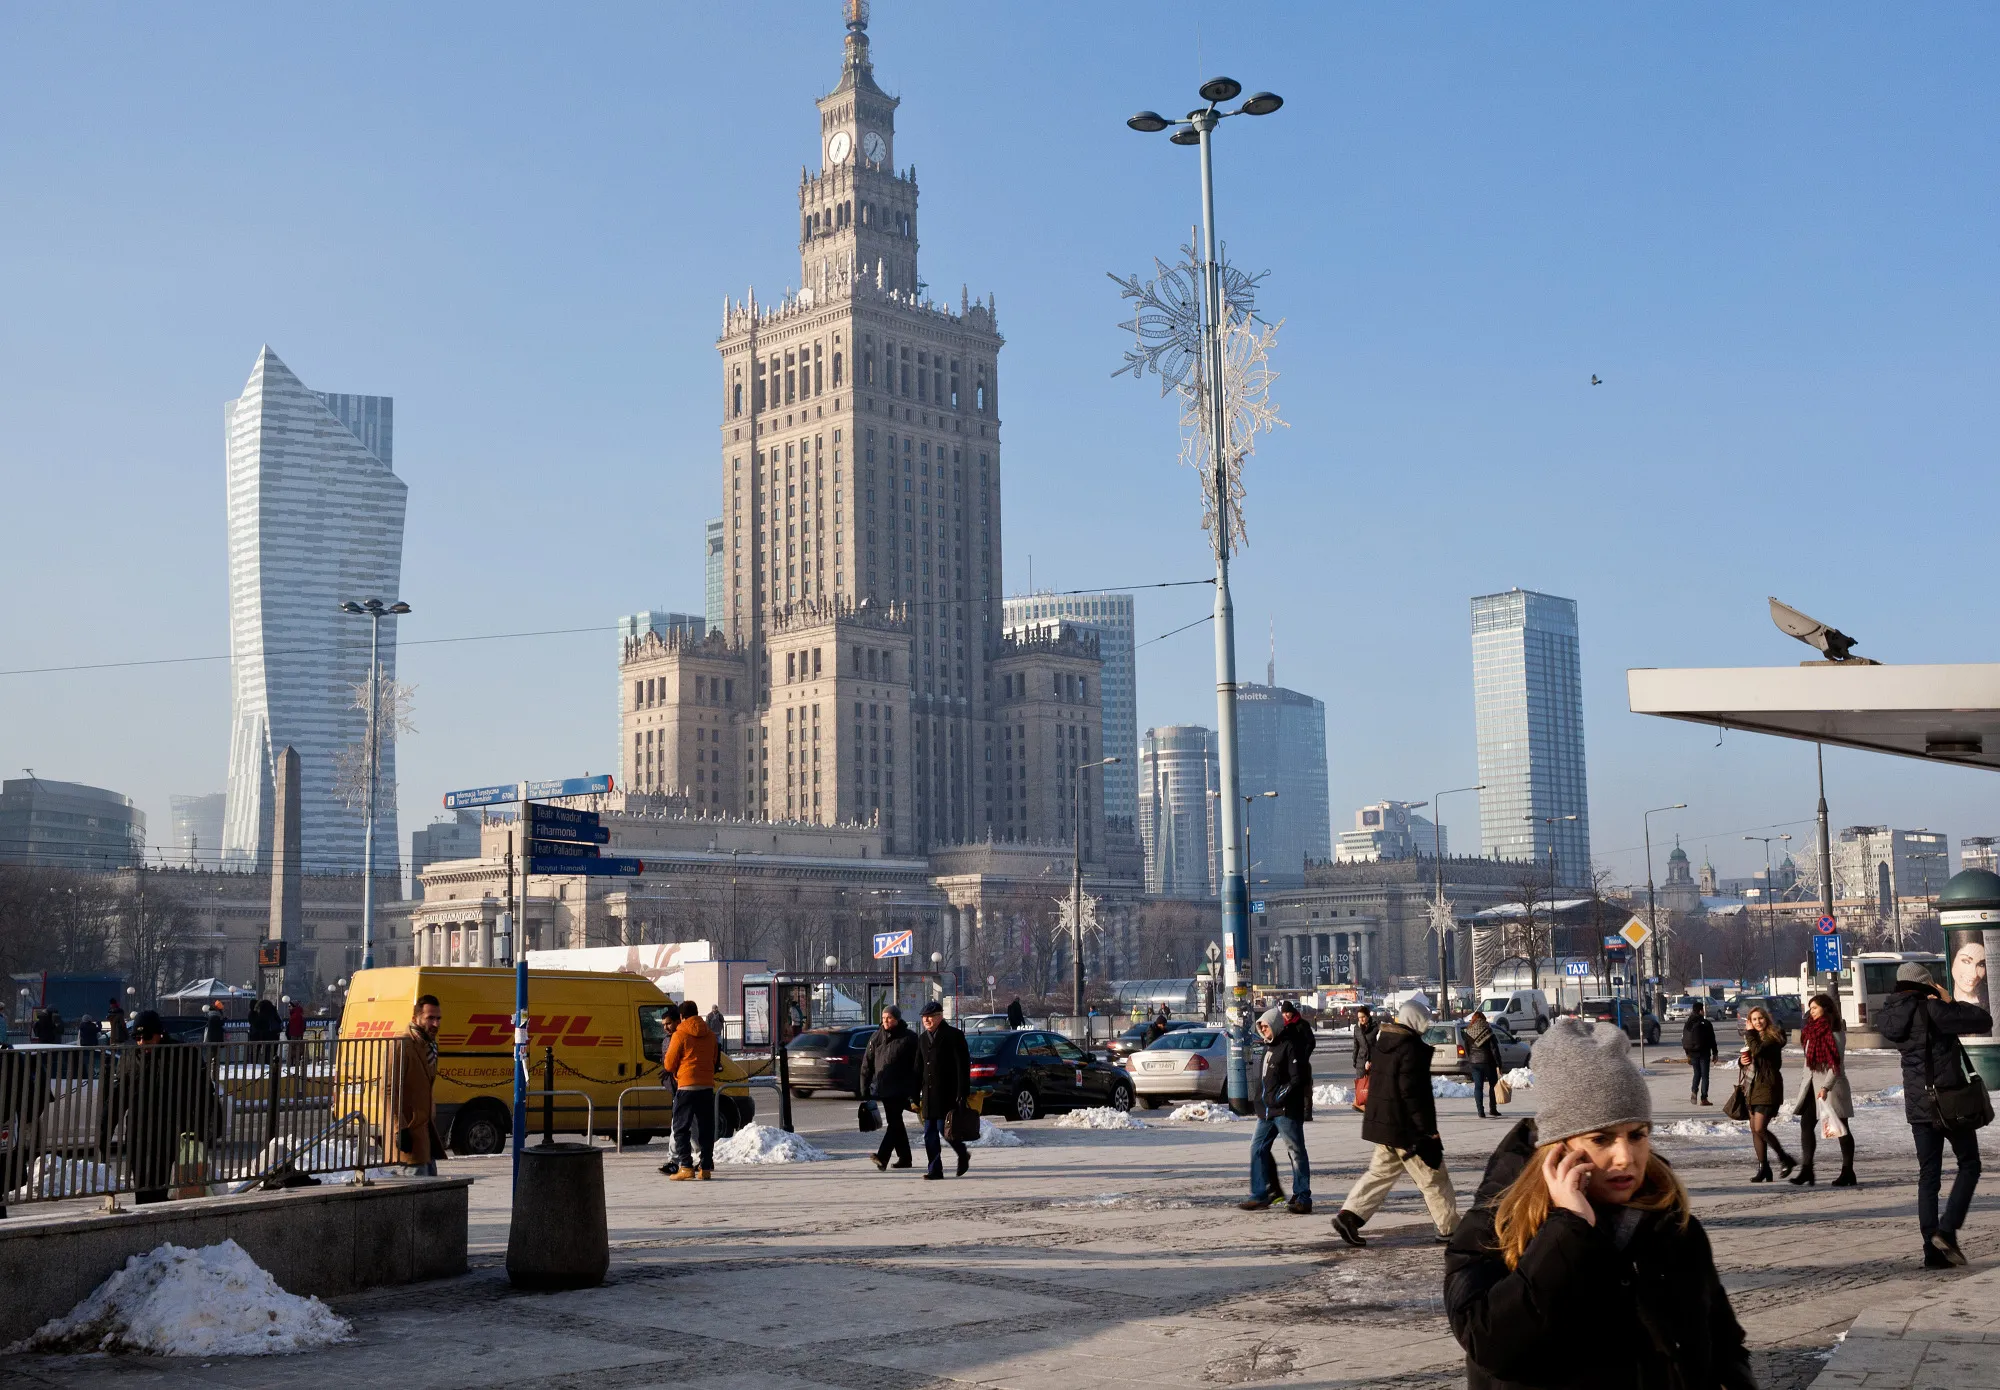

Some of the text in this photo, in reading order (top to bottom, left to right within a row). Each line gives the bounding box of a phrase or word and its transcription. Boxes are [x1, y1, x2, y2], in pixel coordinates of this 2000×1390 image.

[537, 807, 554, 819] Teatr
[556, 811, 582, 823] Kwadrat
[537, 824, 577, 837] Filharmonia
[535, 843, 551, 854] Teatr
[553, 845, 583, 857] Palladium
[537, 864, 558, 872] Instytut
[619, 864, 636, 872] 240m
[1567, 963, 1589, 975] TAXI
[354, 1021, 396, 1038] DHL
[466, 1014, 601, 1046] DHL
